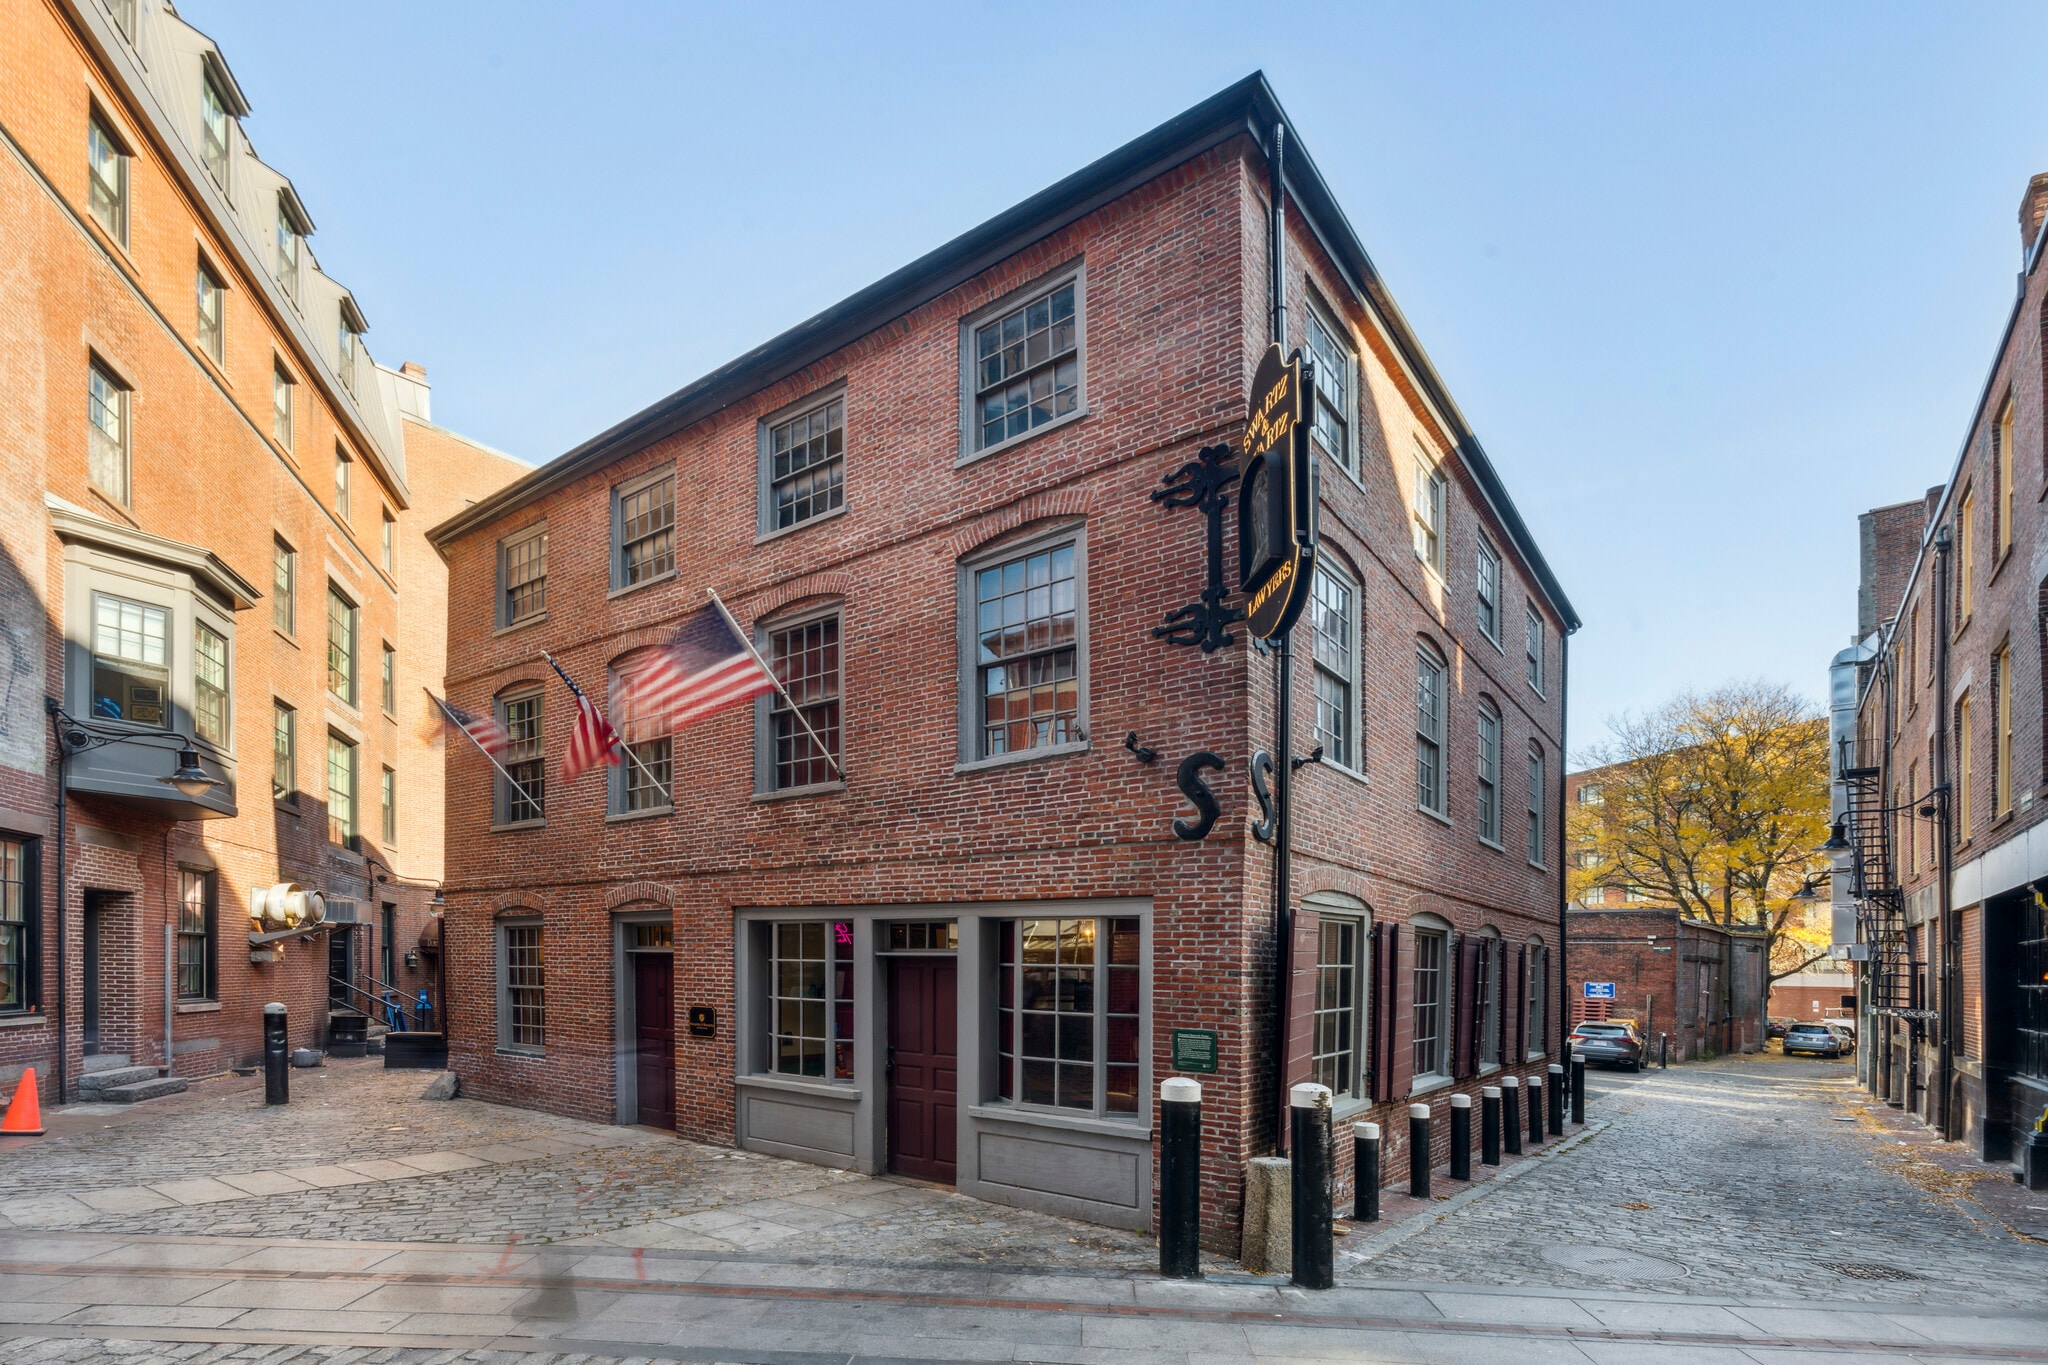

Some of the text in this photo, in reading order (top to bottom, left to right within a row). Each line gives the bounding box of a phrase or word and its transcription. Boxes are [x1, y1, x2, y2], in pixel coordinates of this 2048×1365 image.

[1243, 373, 1288, 454] SWARTZ
[1253, 411, 1288, 456] ARTZ
[1261, 418, 1270, 437] &
[1248, 559, 1291, 618] LAWYERS
